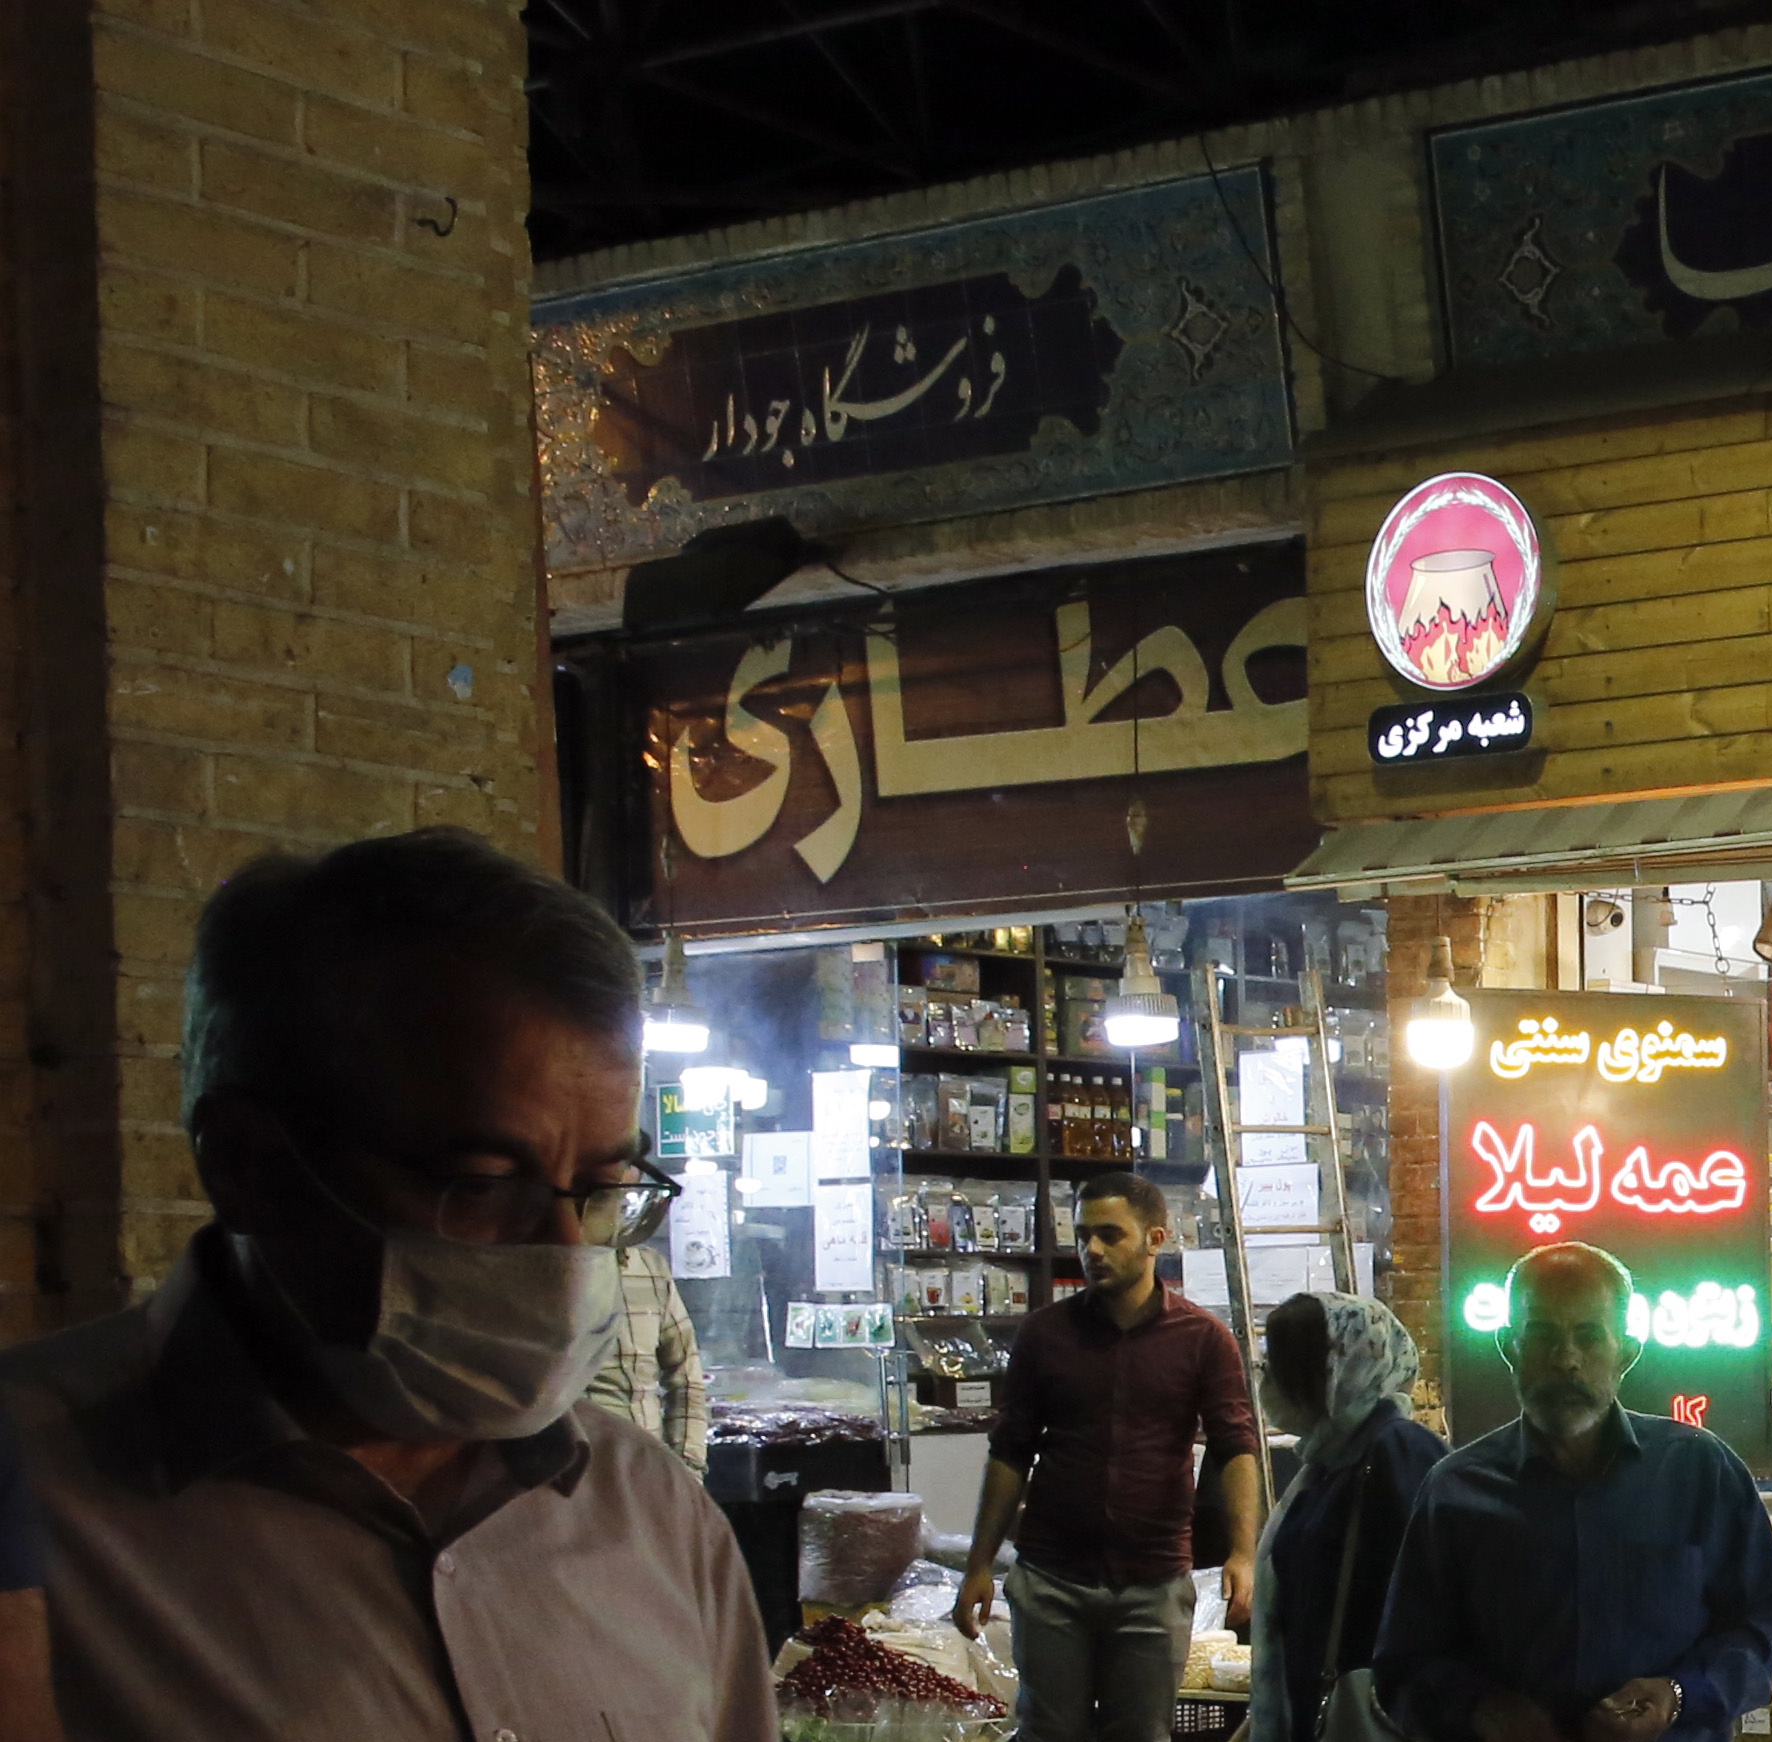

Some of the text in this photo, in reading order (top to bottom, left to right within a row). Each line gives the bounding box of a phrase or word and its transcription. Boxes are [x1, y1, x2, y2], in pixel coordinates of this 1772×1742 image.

[703, 314, 1008, 467] فروشگاه جودار
[670, 597, 1308, 884] عطاری
[1377, 700, 1526, 758] شعبه مرکزی
[1490, 1017, 1728, 1083] سمنوی سنتی
[1472, 1120, 1748, 1233] عمه لیلا
